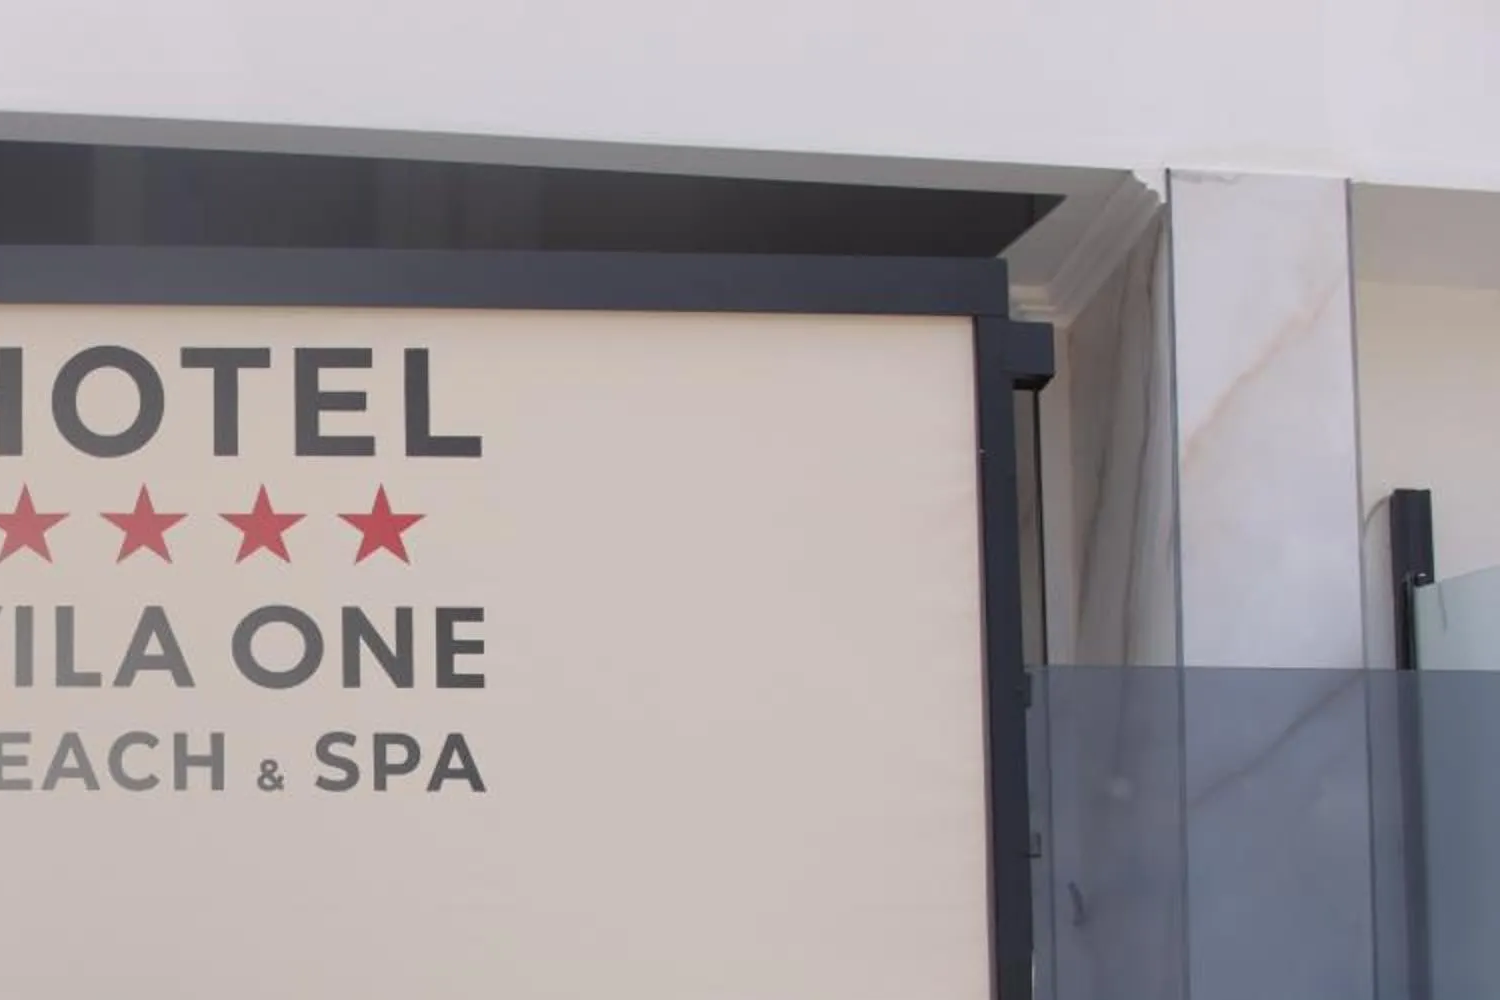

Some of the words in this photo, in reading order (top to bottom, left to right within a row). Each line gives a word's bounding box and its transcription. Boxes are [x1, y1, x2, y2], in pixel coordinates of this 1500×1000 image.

[231, 604, 487, 690] ONE
[256, 758, 286, 793] &
[315, 730, 488, 793] SPA
